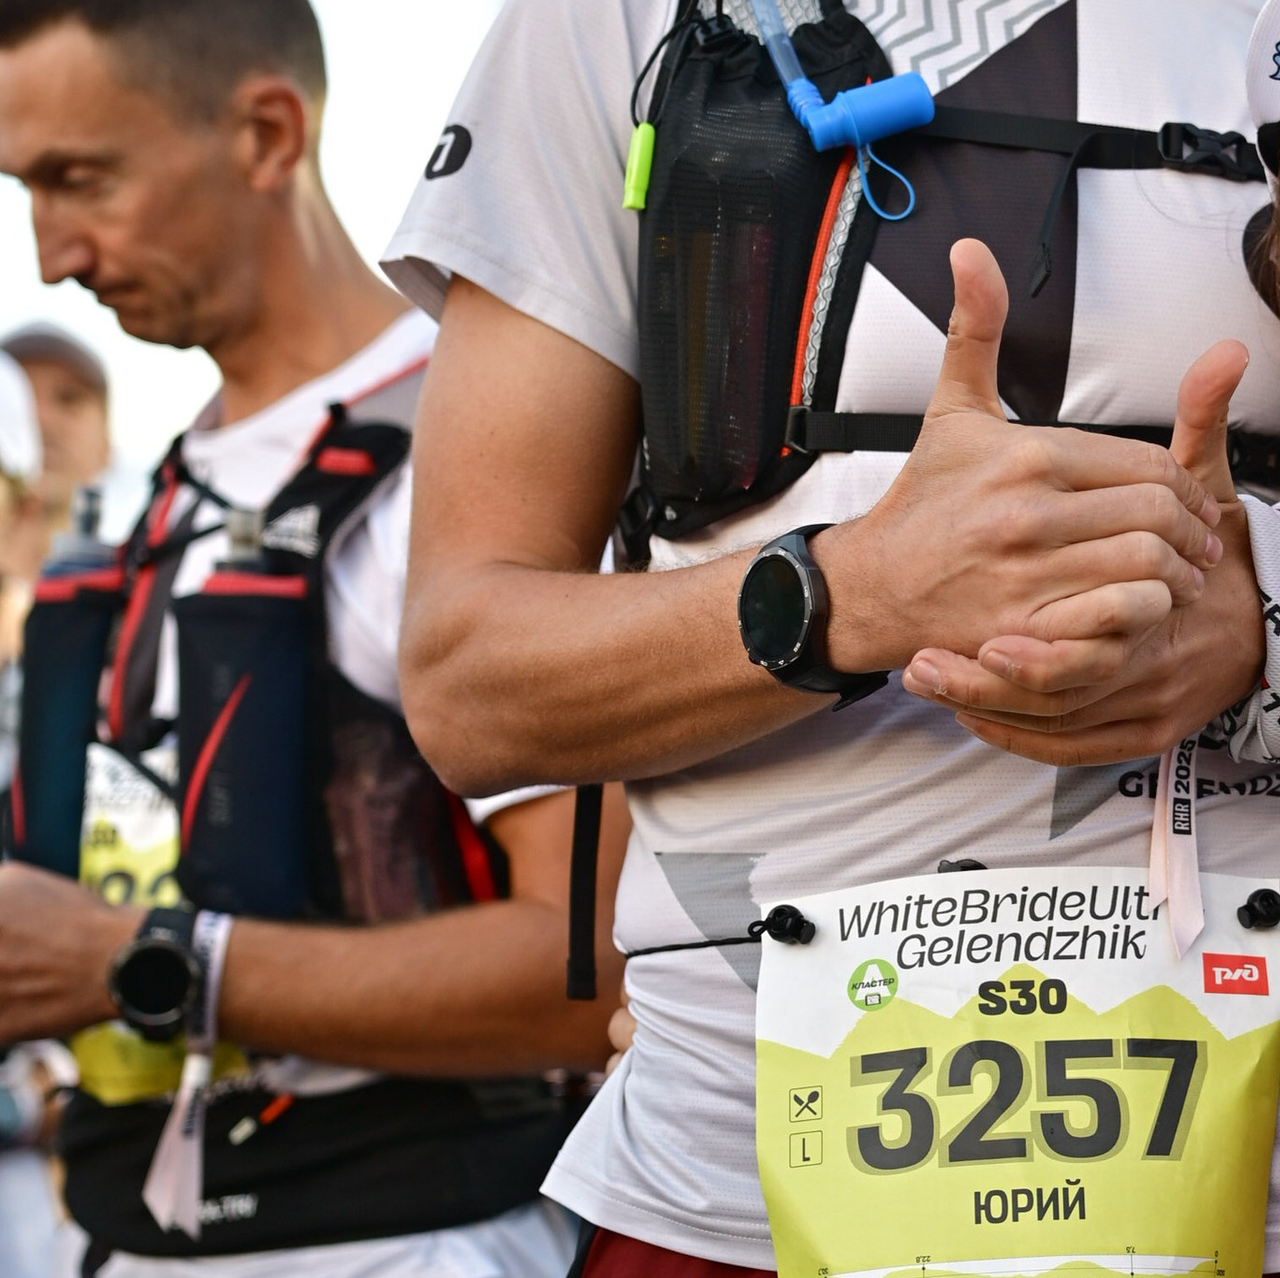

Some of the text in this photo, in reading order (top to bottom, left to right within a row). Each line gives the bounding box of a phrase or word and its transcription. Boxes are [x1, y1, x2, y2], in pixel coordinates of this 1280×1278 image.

[1174, 739, 1196, 832] RHR 2025
[839, 885, 1167, 942] WhiteBrideUlt
[897, 927, 1147, 969] Gelendzhik
[851, 977, 895, 991] КЛАСТЕР
[978, 978, 1068, 1015] S30
[853, 1038, 1202, 1171] 3257
[973, 1178, 1087, 1225] ЮРИЙ
